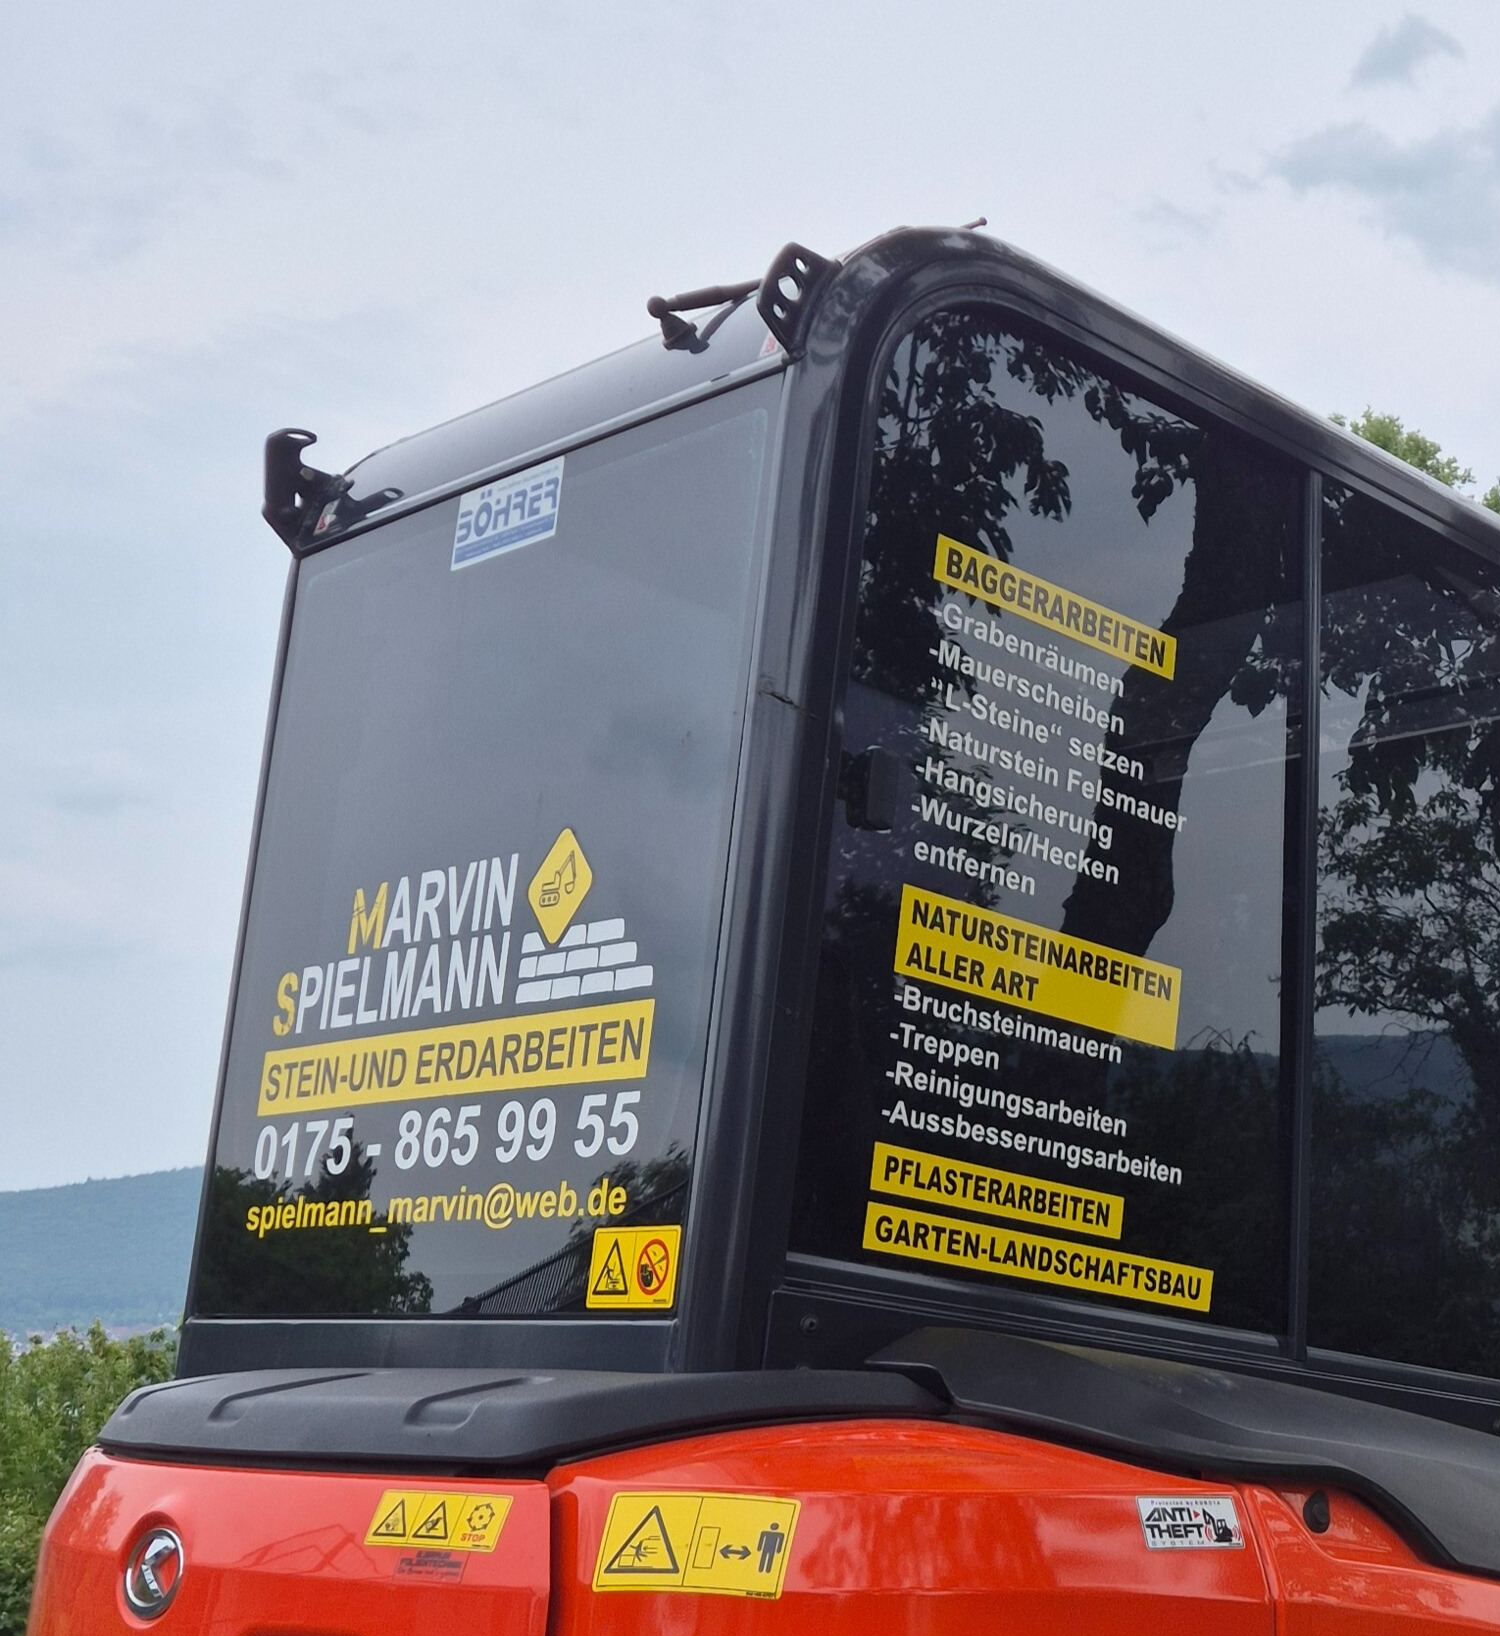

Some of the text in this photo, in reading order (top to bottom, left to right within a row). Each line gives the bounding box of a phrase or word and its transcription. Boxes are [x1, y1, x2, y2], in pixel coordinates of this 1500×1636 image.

[933, 602, 1124, 698] -Grabenräumen
[947, 548, 1165, 668] BAGGERARBEITEN
[929, 639, 1124, 736] -Mauerscheiben
[920, 719, 1187, 833] -Naturstein Felsmauer
[1069, 736, 1144, 781] setzen
[911, 794, 1119, 885] -Wurzeln/Hecken
[915, 757, 1113, 849] -Hangsicherung
[348, 853, 518, 954] MARVIN
[914, 838, 1035, 896] entfernen
[273, 931, 510, 1035] SPIELMANN
[905, 942, 1039, 1002] ALLER ART
[911, 898, 1172, 1001] NATURSTEINARBEITEN
[266, 1018, 645, 1101] STEIN-UND ERDARBEITEN
[889, 1022, 999, 1070] -Treppen
[893, 985, 1122, 1064] -Bruchsteinmauern
[254, 1117, 353, 1179] 0175
[394, 1104, 481, 1169] 865
[495, 1098, 556, 1163] 99
[575, 1091, 640, 1157] 55
[885, 1060, 1127, 1138] -Reinigungsarbeiten
[881, 1100, 1182, 1185] -Aussbesserungsarbeiten
[246, 1178, 627, 1238] spielmann_marvin@web.de
[884, 1154, 1110, 1228] PFLASTERARBEITEN
[875, 1214, 1201, 1300] GARTEN-LANDSCHAFTSBAU
[460, 1532, 486, 1542] STOP
[1145, 1507, 1193, 1522] ANTI
[1145, 1524, 1203, 1538] THEFT
